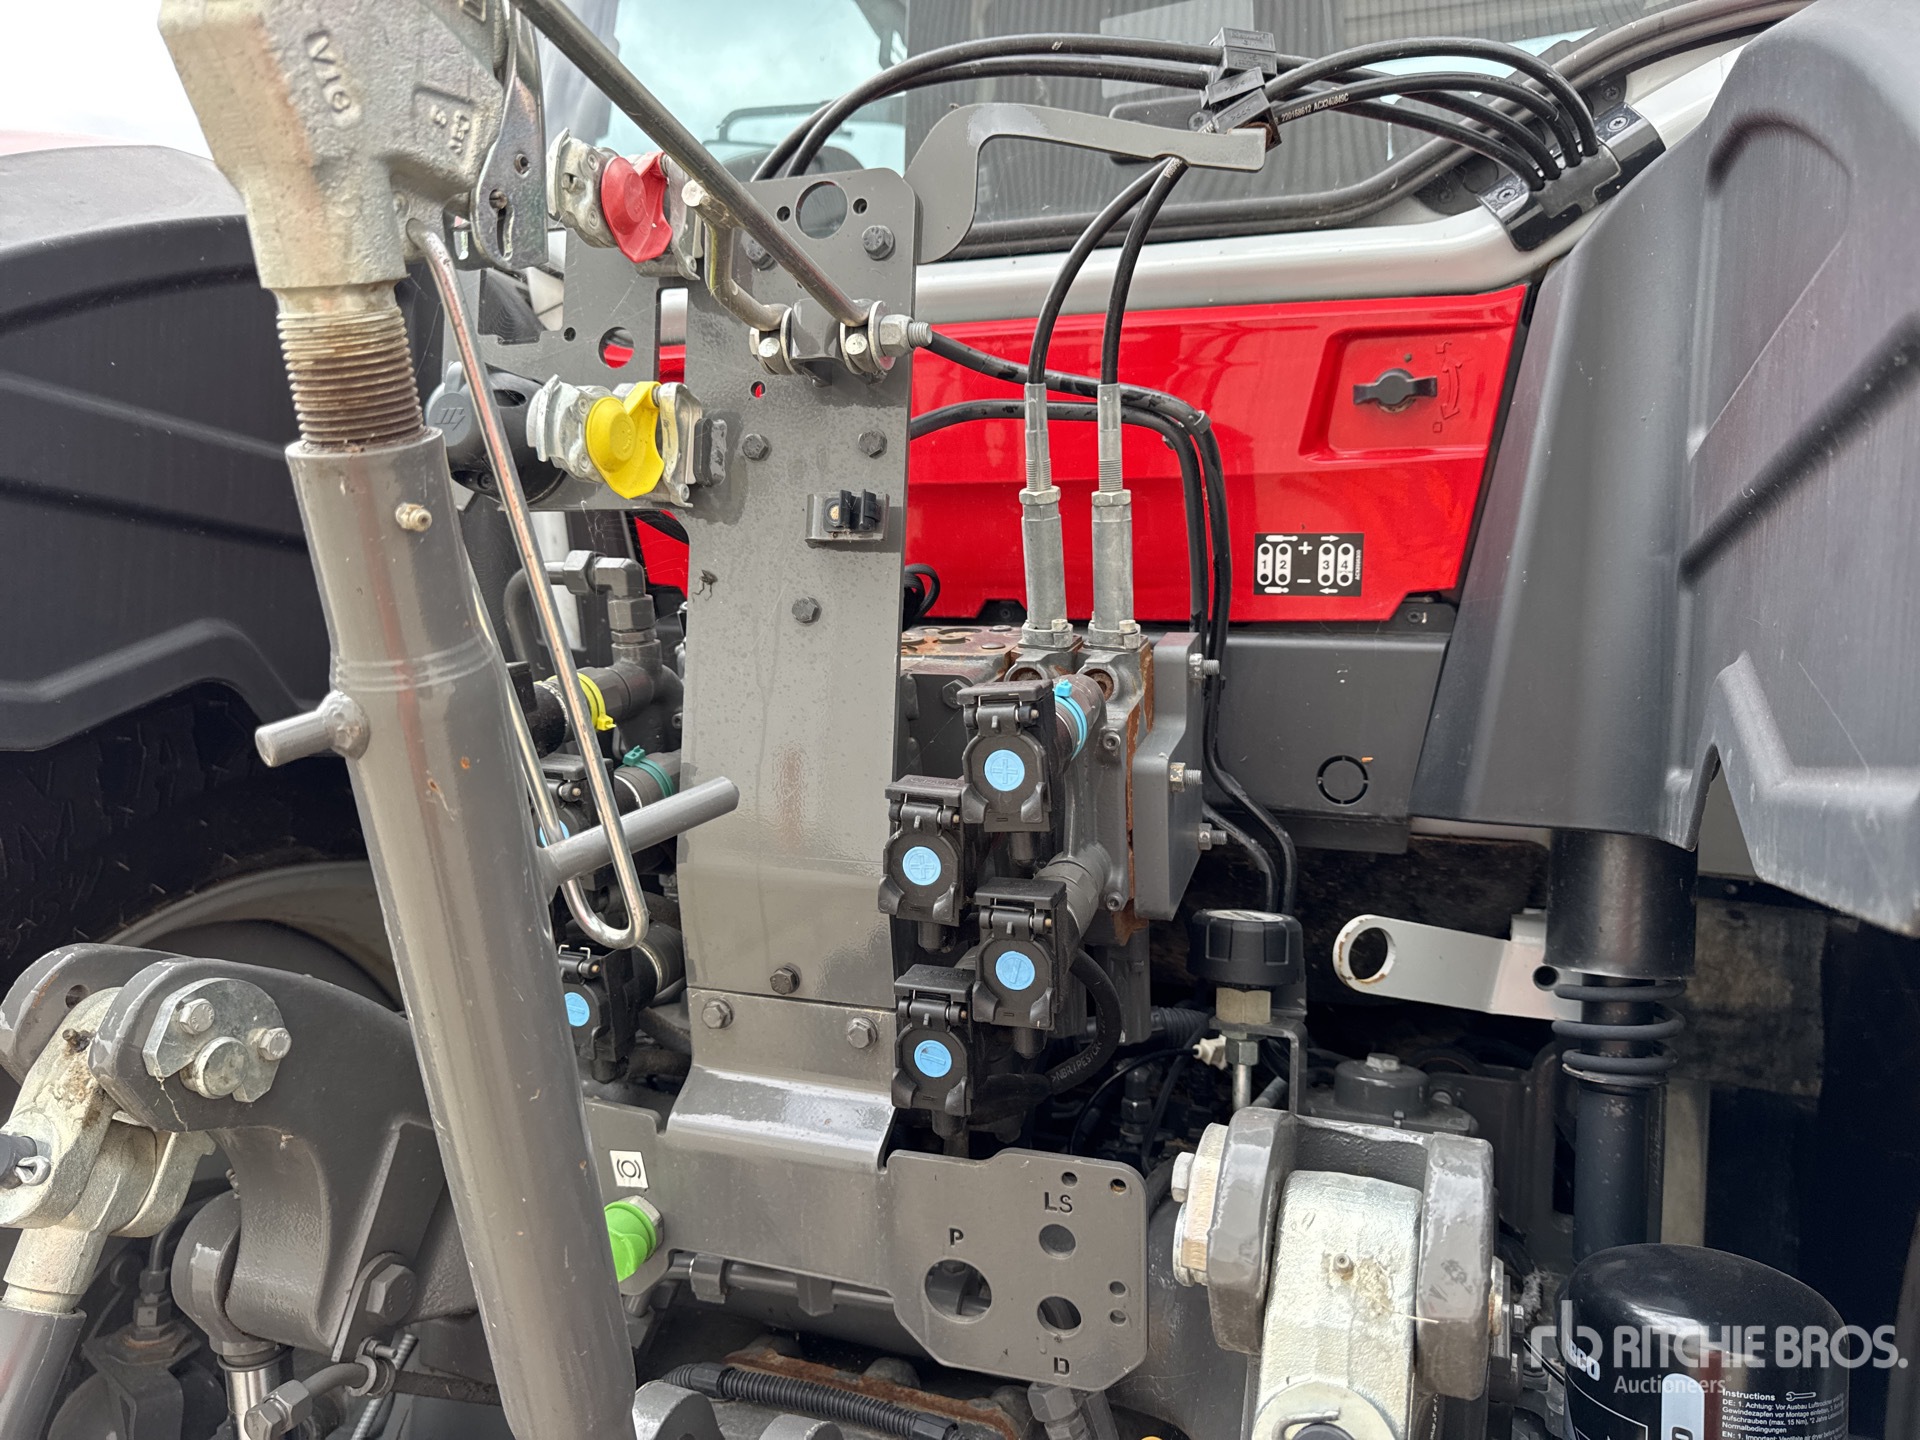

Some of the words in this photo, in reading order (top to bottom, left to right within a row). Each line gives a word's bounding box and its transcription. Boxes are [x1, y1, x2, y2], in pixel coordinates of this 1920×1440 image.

[1261, 560, 1267, 569] 1
[1279, 560, 1287, 570] 2
[1322, 560, 1330, 570] 3
[1341, 560, 1348, 570] 4
[1043, 1192, 1073, 1214] LS
[949, 1227, 964, 1246] P
[1053, 1356, 1070, 1376] D
[1722, 1388, 1776, 1401] Instructions
